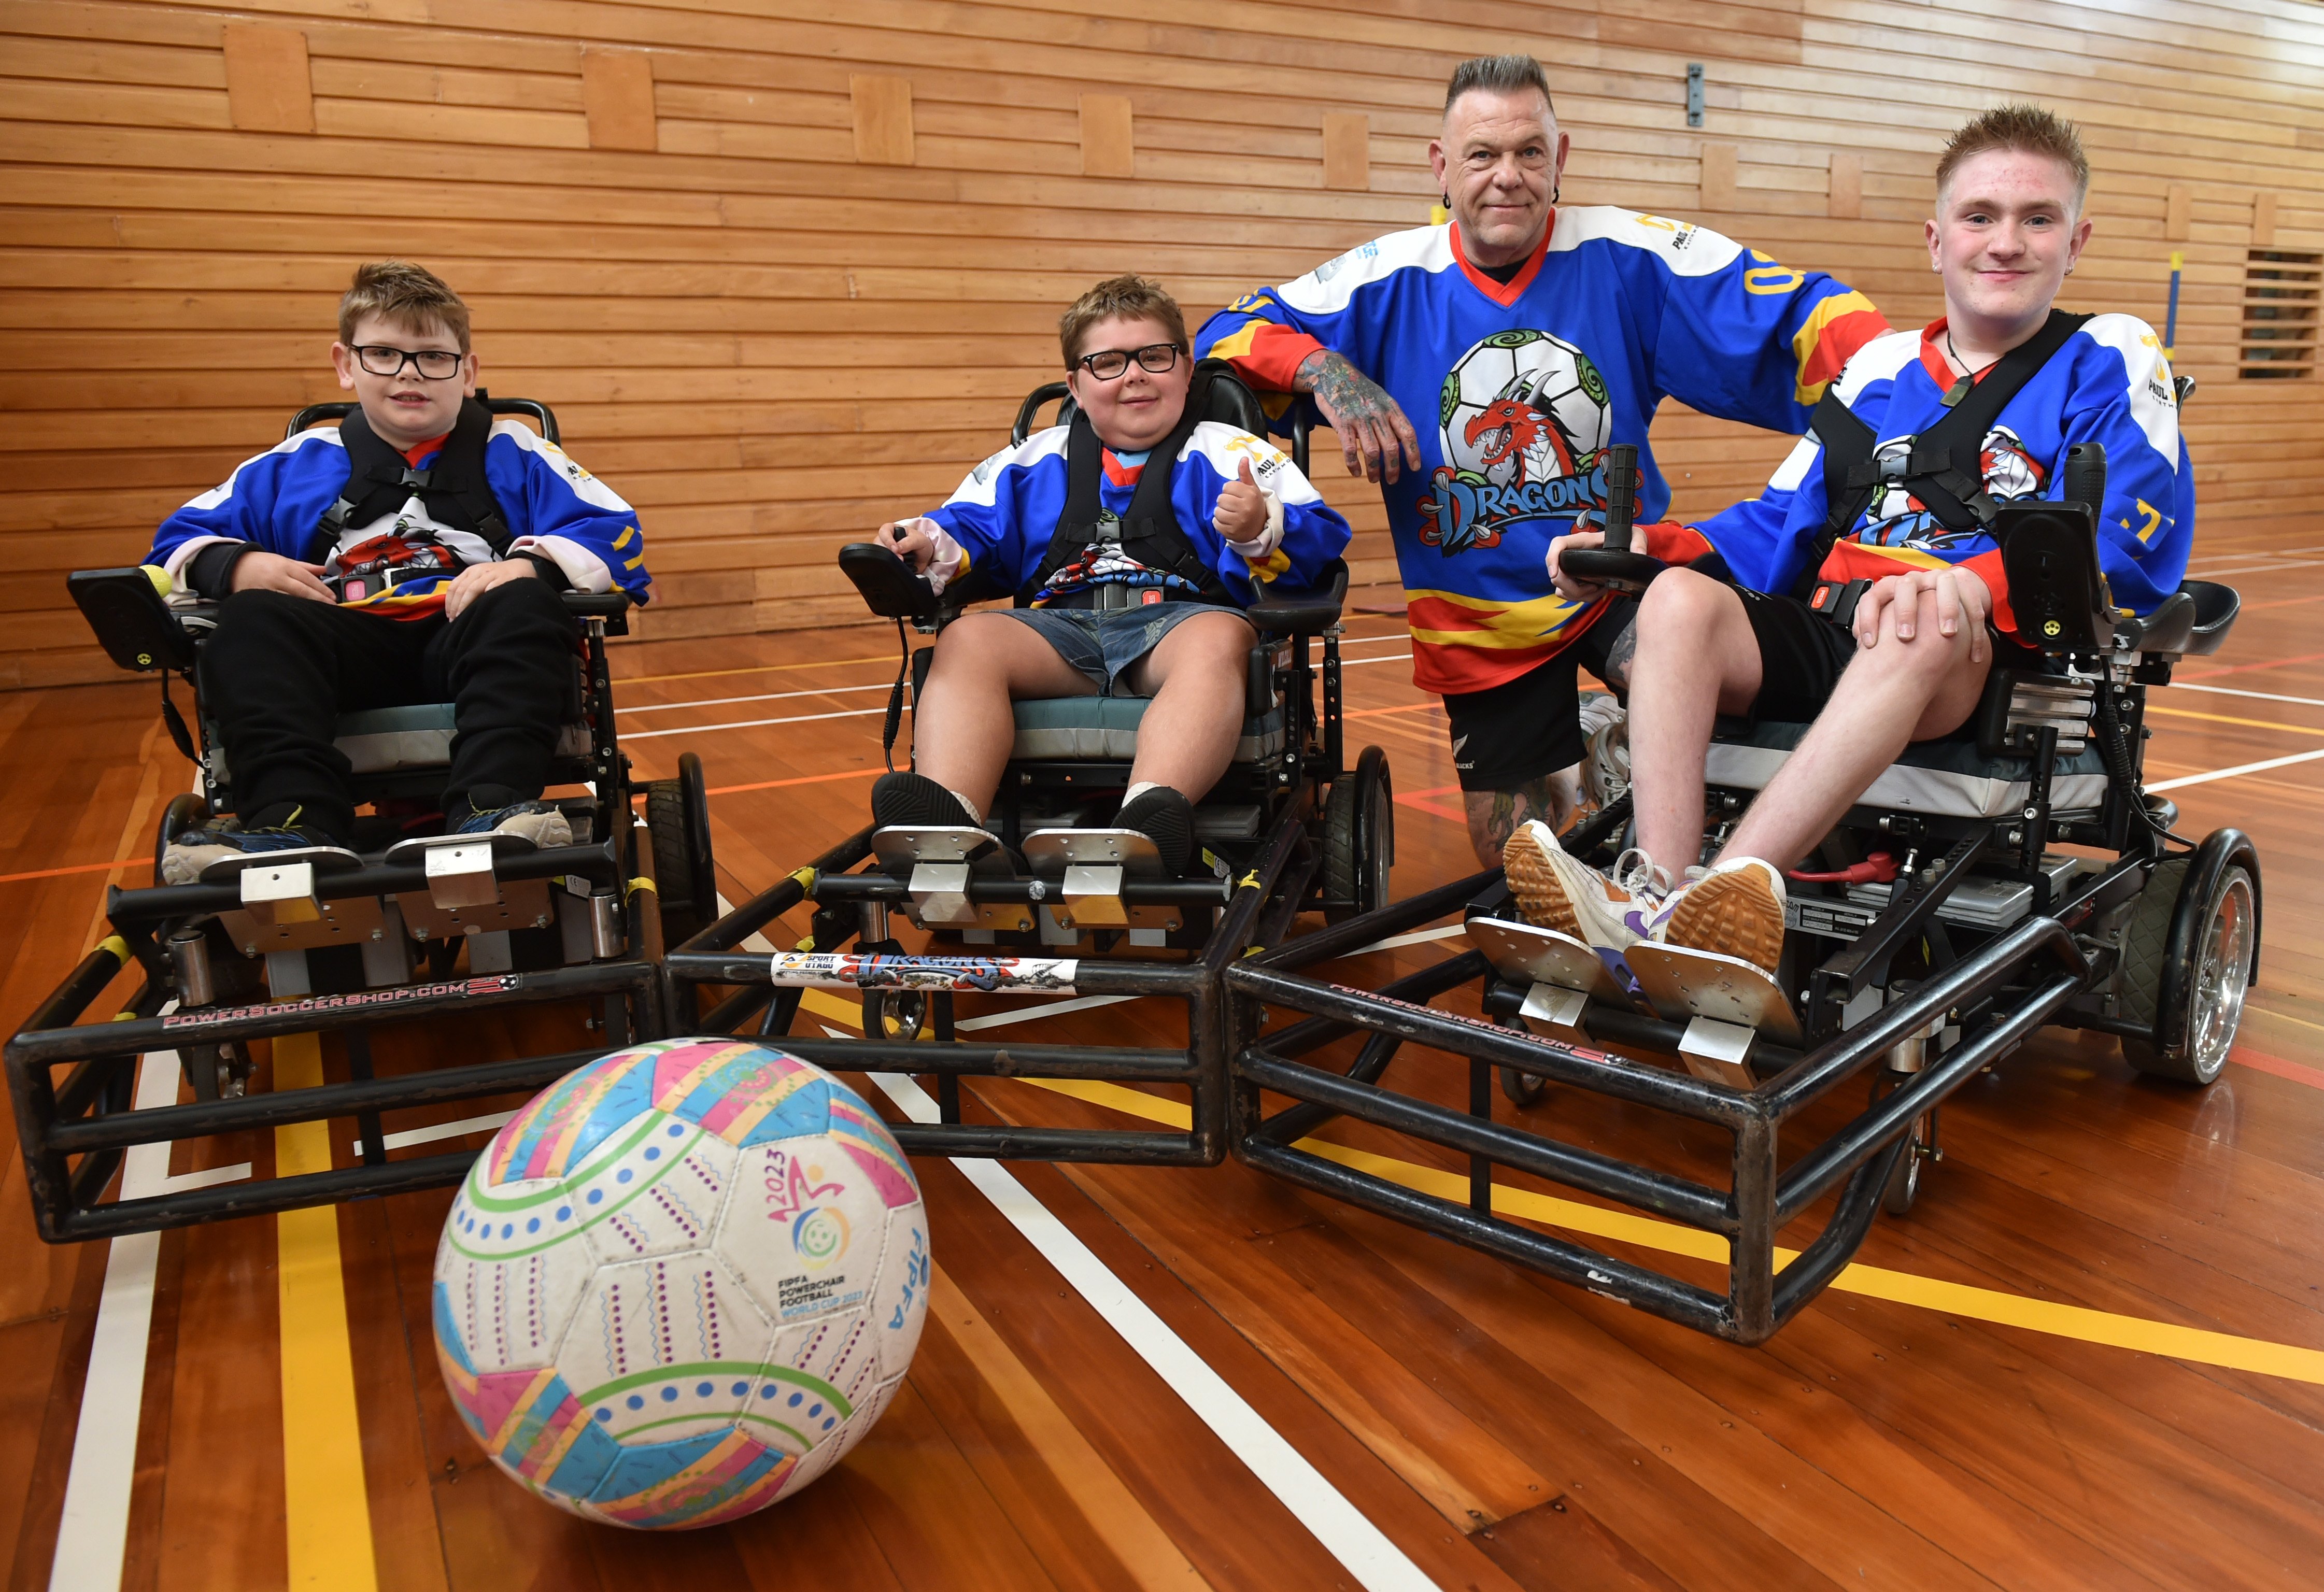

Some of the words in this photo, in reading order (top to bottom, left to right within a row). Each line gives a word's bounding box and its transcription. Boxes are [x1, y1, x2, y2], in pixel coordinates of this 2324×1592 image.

[1672, 231, 1688, 250] PAUL
[2149, 378, 2168, 400] PAUL
[163, 983, 464, 1027] POWERSOCCERSHOP.COM
[764, 1148, 786, 1206] 2023
[778, 1275, 809, 1289] FIPFA
[780, 1276, 845, 1299] POWERCHAIR
[888, 1227, 922, 1330] FIPFA
[780, 1289, 833, 1309] FOOTBALL
[781, 1302, 818, 1318] WORLD
[821, 1297, 840, 1310] CUP
[843, 1290, 863, 1303] 2023
